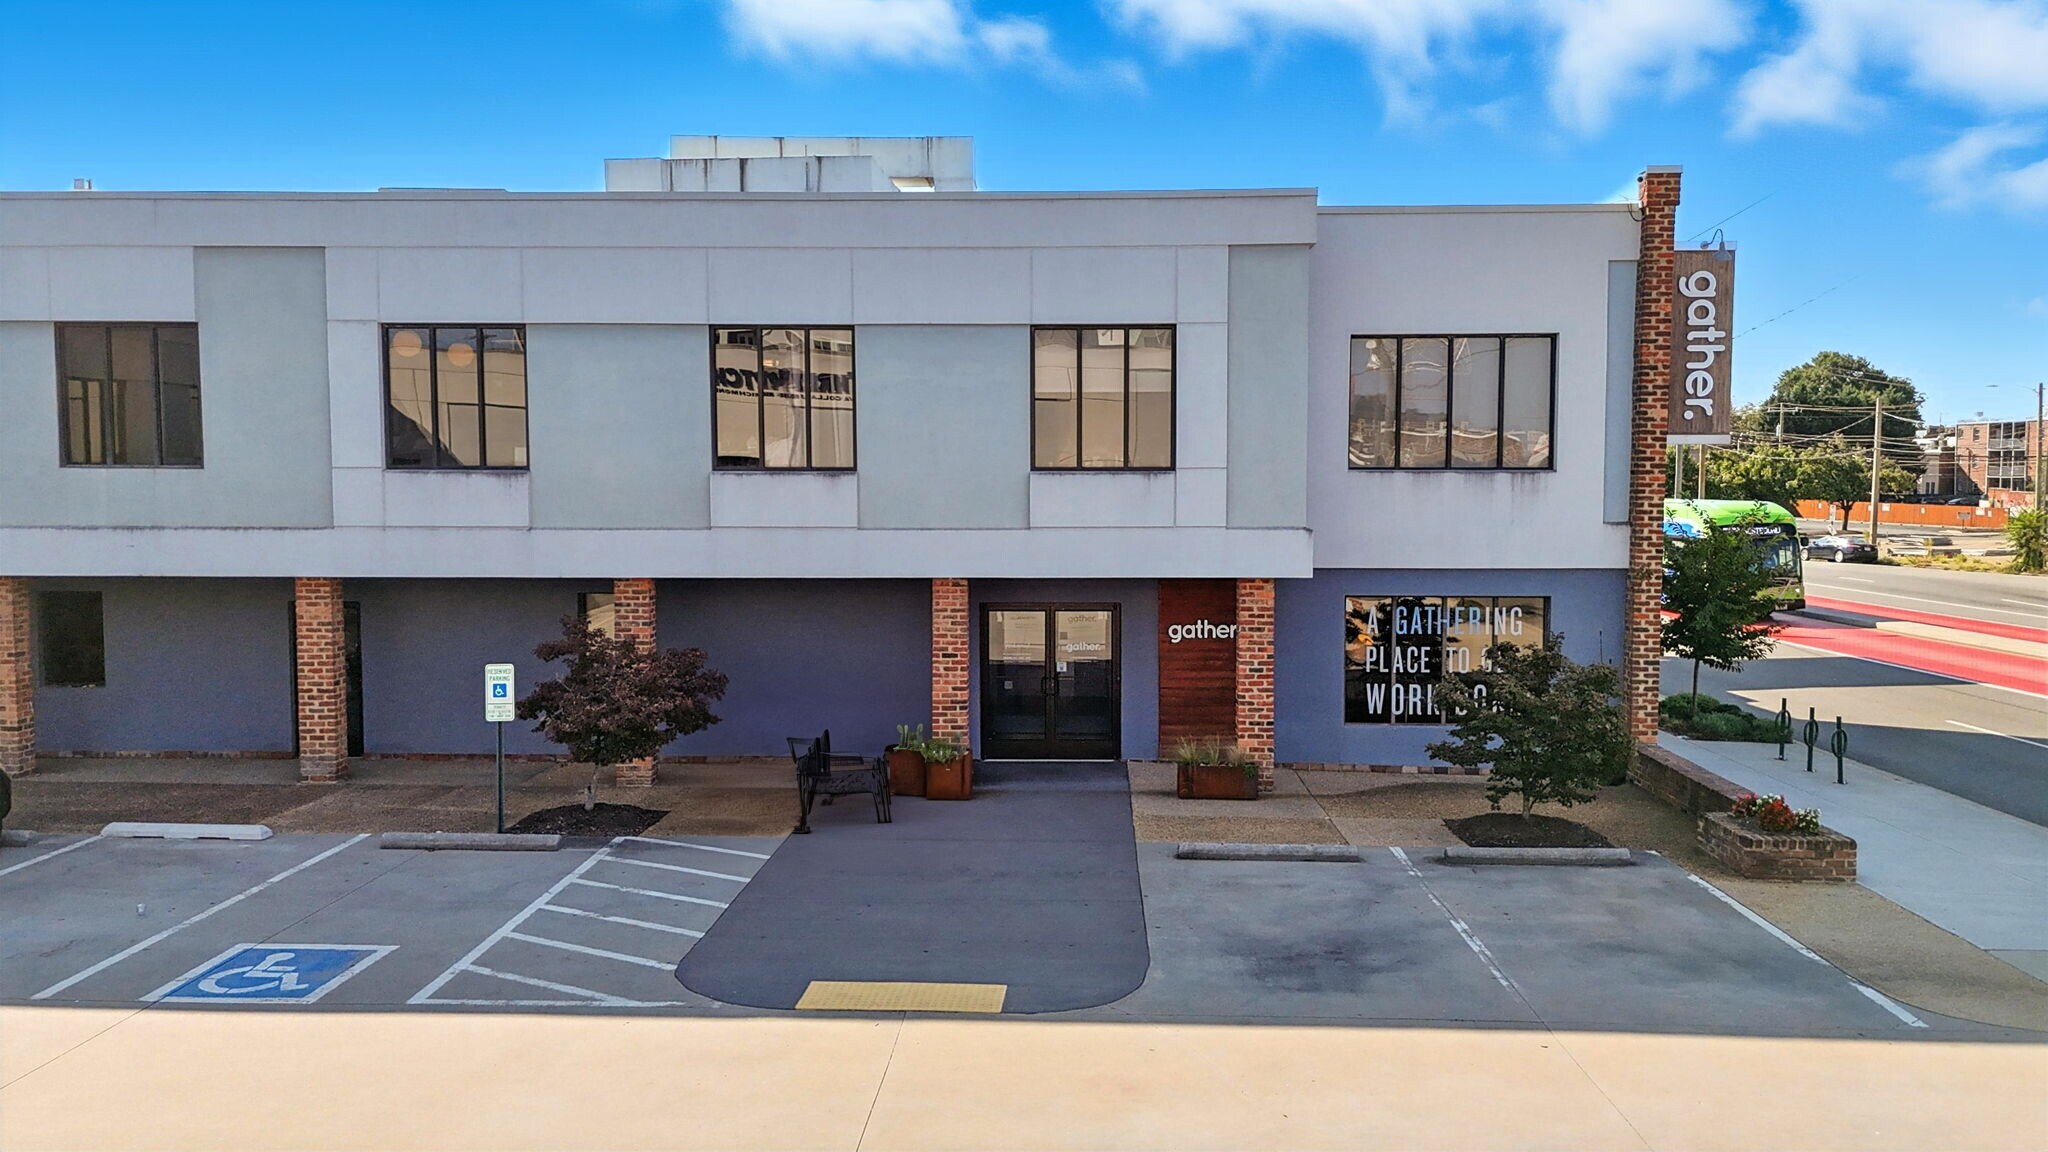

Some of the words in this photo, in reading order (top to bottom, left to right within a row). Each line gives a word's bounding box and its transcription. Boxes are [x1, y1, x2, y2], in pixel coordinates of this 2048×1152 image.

[1679, 270, 1726, 420] gather.
[1367, 606, 1378, 634] A
[1395, 606, 1523, 636] GATHERING
[1365, 646, 1431, 673] PLACE
[1446, 646, 1470, 674] TO
[1366, 683, 1441, 716] WORK
